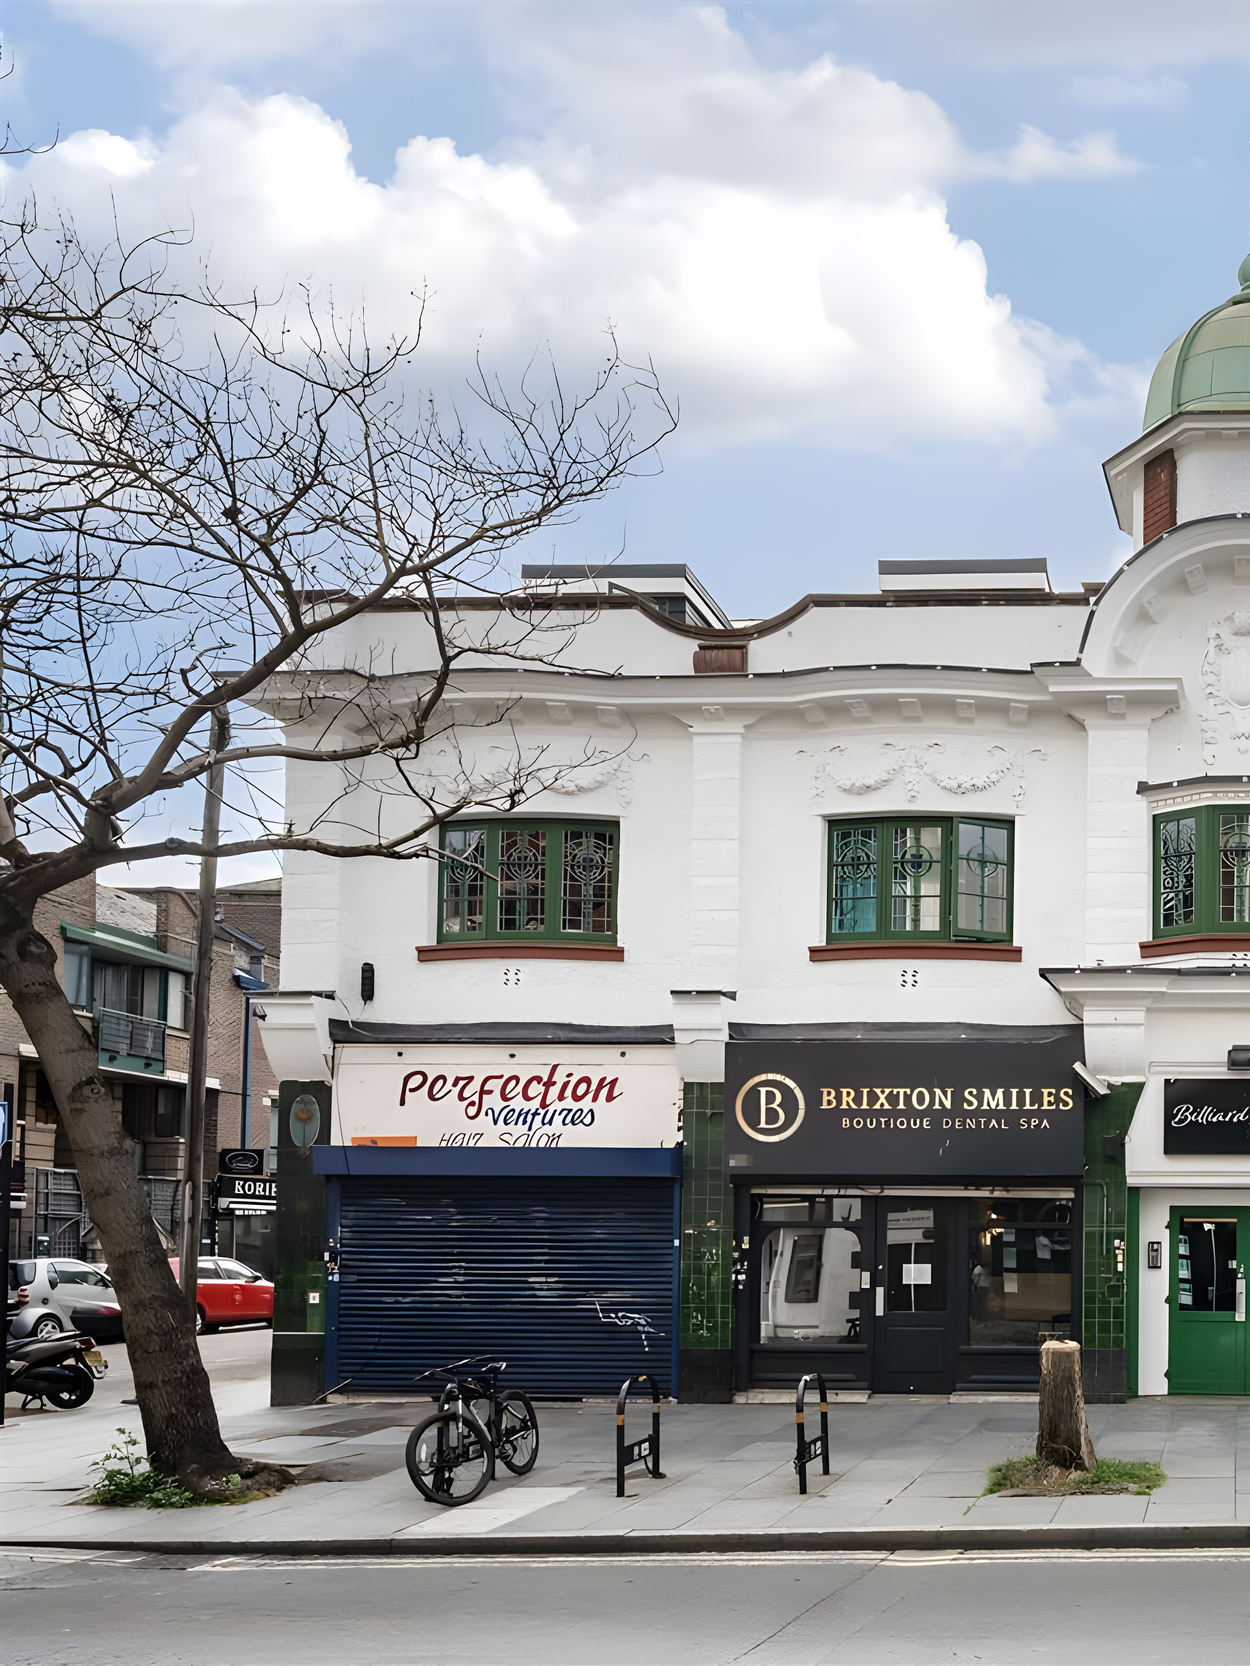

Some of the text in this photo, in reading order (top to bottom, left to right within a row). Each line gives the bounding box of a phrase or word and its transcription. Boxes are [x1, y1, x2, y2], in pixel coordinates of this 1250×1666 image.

[399, 1064, 624, 1120] Perfection
[819, 1087, 1075, 1111] BRIXTON SMILES
[756, 1086, 786, 1129] B
[1171, 1103, 1250, 1127] Billiard
[841, 1117, 1051, 1130] BOUTIQUE DENTAL SPA
